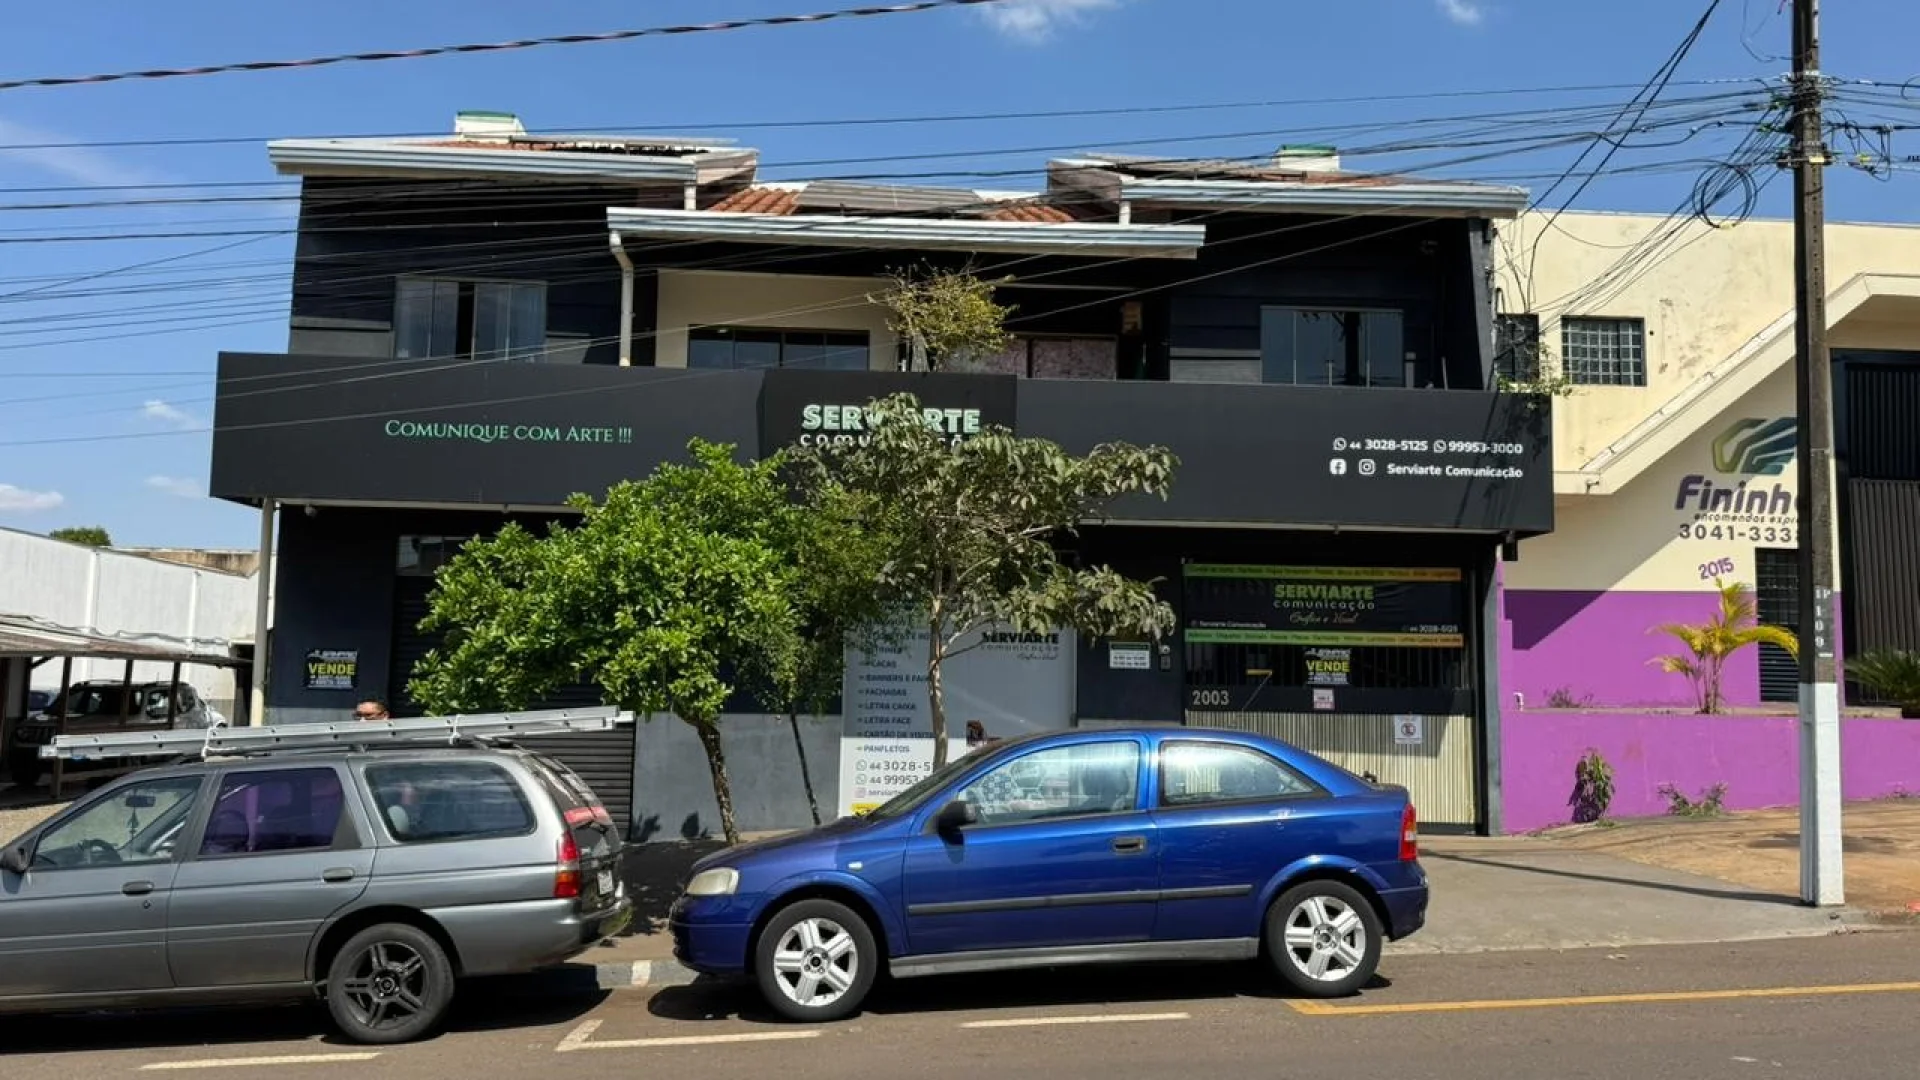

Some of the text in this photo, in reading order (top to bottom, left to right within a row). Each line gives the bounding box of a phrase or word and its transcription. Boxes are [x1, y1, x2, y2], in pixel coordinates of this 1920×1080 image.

[1364, 439, 1429, 451] 3028-5125
[1448, 441, 1524, 454] 99953-3000
[1386, 463, 1524, 478] Serviarte Comunicação
[1675, 474, 1798, 515] Fininh
[1680, 523, 1798, 542] 3041-333
[1697, 557, 1734, 580] 2015
[1274, 584, 1374, 600] SERVIARTE
[1273, 600, 1375, 611] comunicação
[308, 662, 356, 675] VENDE
[1305, 660, 1351, 672] VENDE
[1192, 689, 1230, 706] 2003
